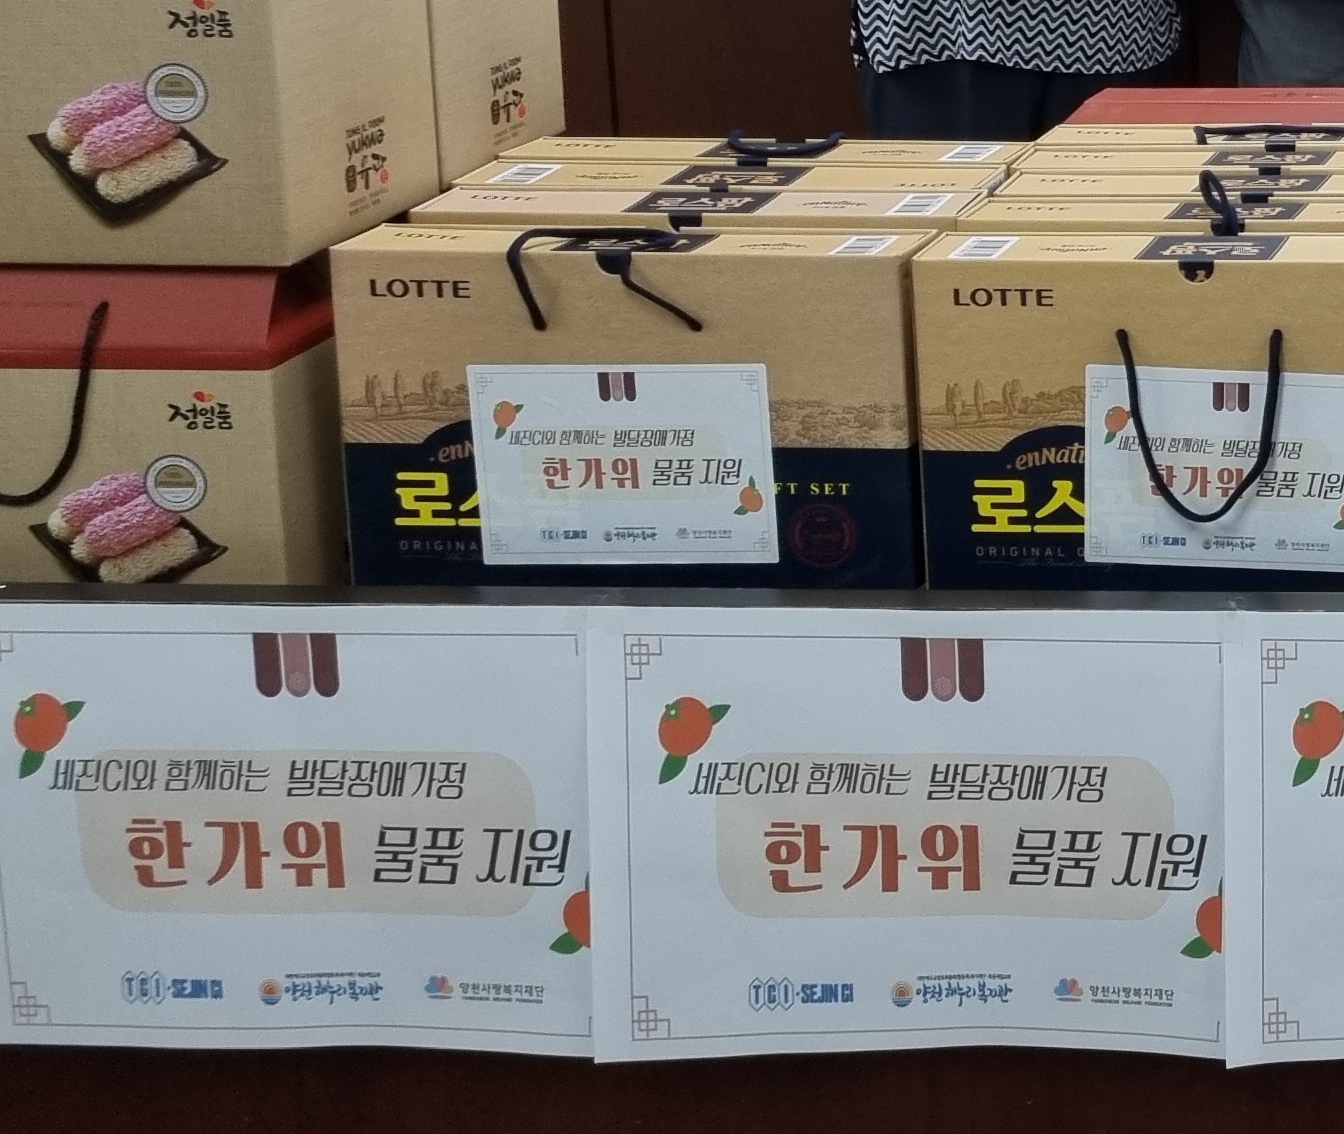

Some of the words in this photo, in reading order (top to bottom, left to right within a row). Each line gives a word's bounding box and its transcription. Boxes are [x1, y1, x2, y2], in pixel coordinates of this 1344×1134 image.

[167, 9, 235, 39] 정일품
[369, 278, 472, 299] LOTTE
[952, 287, 1055, 308] LOTTE
[167, 402, 234, 431] 정일품
[559, 429, 606, 447] 함께하는
[612, 428, 695, 449] 발달장애가정
[1167, 437, 1215, 454] 함께하는
[1014, 442, 1085, 471] enNat
[541, 456, 641, 491] 한가위
[651, 457, 695, 488] 물품
[699, 457, 742, 487] 지원
[1255, 469, 1300, 498] 물품
[810, 481, 852, 496] SET
[970, 479, 1086, 533] 로스
[975, 546, 1066, 557] ORIGINAL
[48, 759, 158, 793] 세진CI와
[164, 759, 270, 793] 함께하는
[286, 759, 467, 801] 발달장애가정
[688, 761, 800, 797] 세진CI와
[805, 762, 912, 797] 함께하는
[925, 763, 1108, 804] 발달장애가정
[125, 817, 347, 891] 한가위
[372, 824, 465, 886] 물품
[475, 826, 574, 888] 지원
[763, 820, 983, 894] 한가위
[1008, 826, 1105, 889] 물품
[1110, 831, 1208, 892] 지원
[751, 979, 793, 1009] TCI
[1088, 984, 1176, 1002] 양천사랑복지재단
